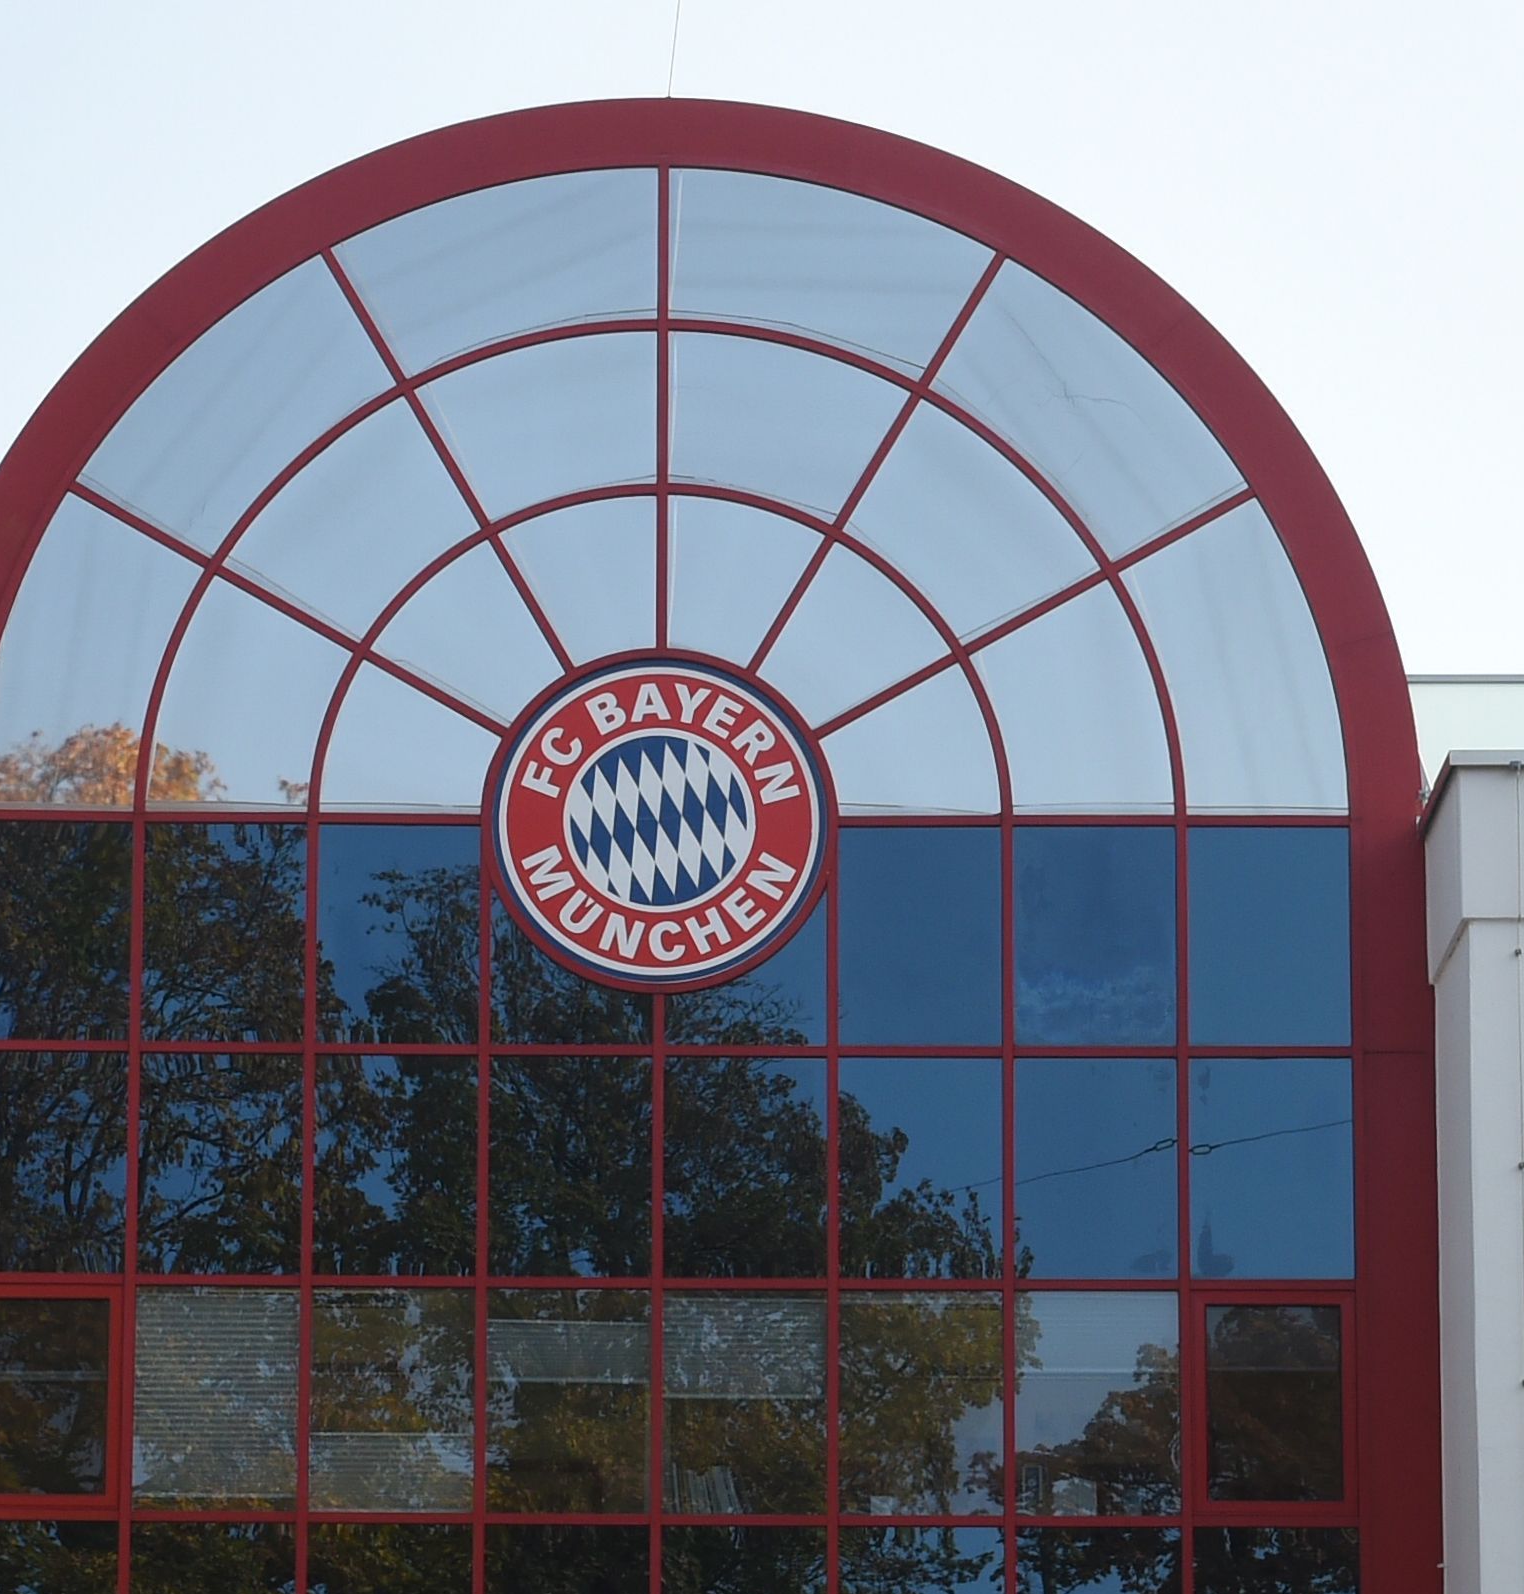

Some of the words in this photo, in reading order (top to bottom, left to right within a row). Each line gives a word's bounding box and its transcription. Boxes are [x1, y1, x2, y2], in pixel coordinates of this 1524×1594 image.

[521, 727, 583, 798] FC
[585, 683, 801, 805] BAYERN
[521, 845, 797, 961] MÜNCHEN
